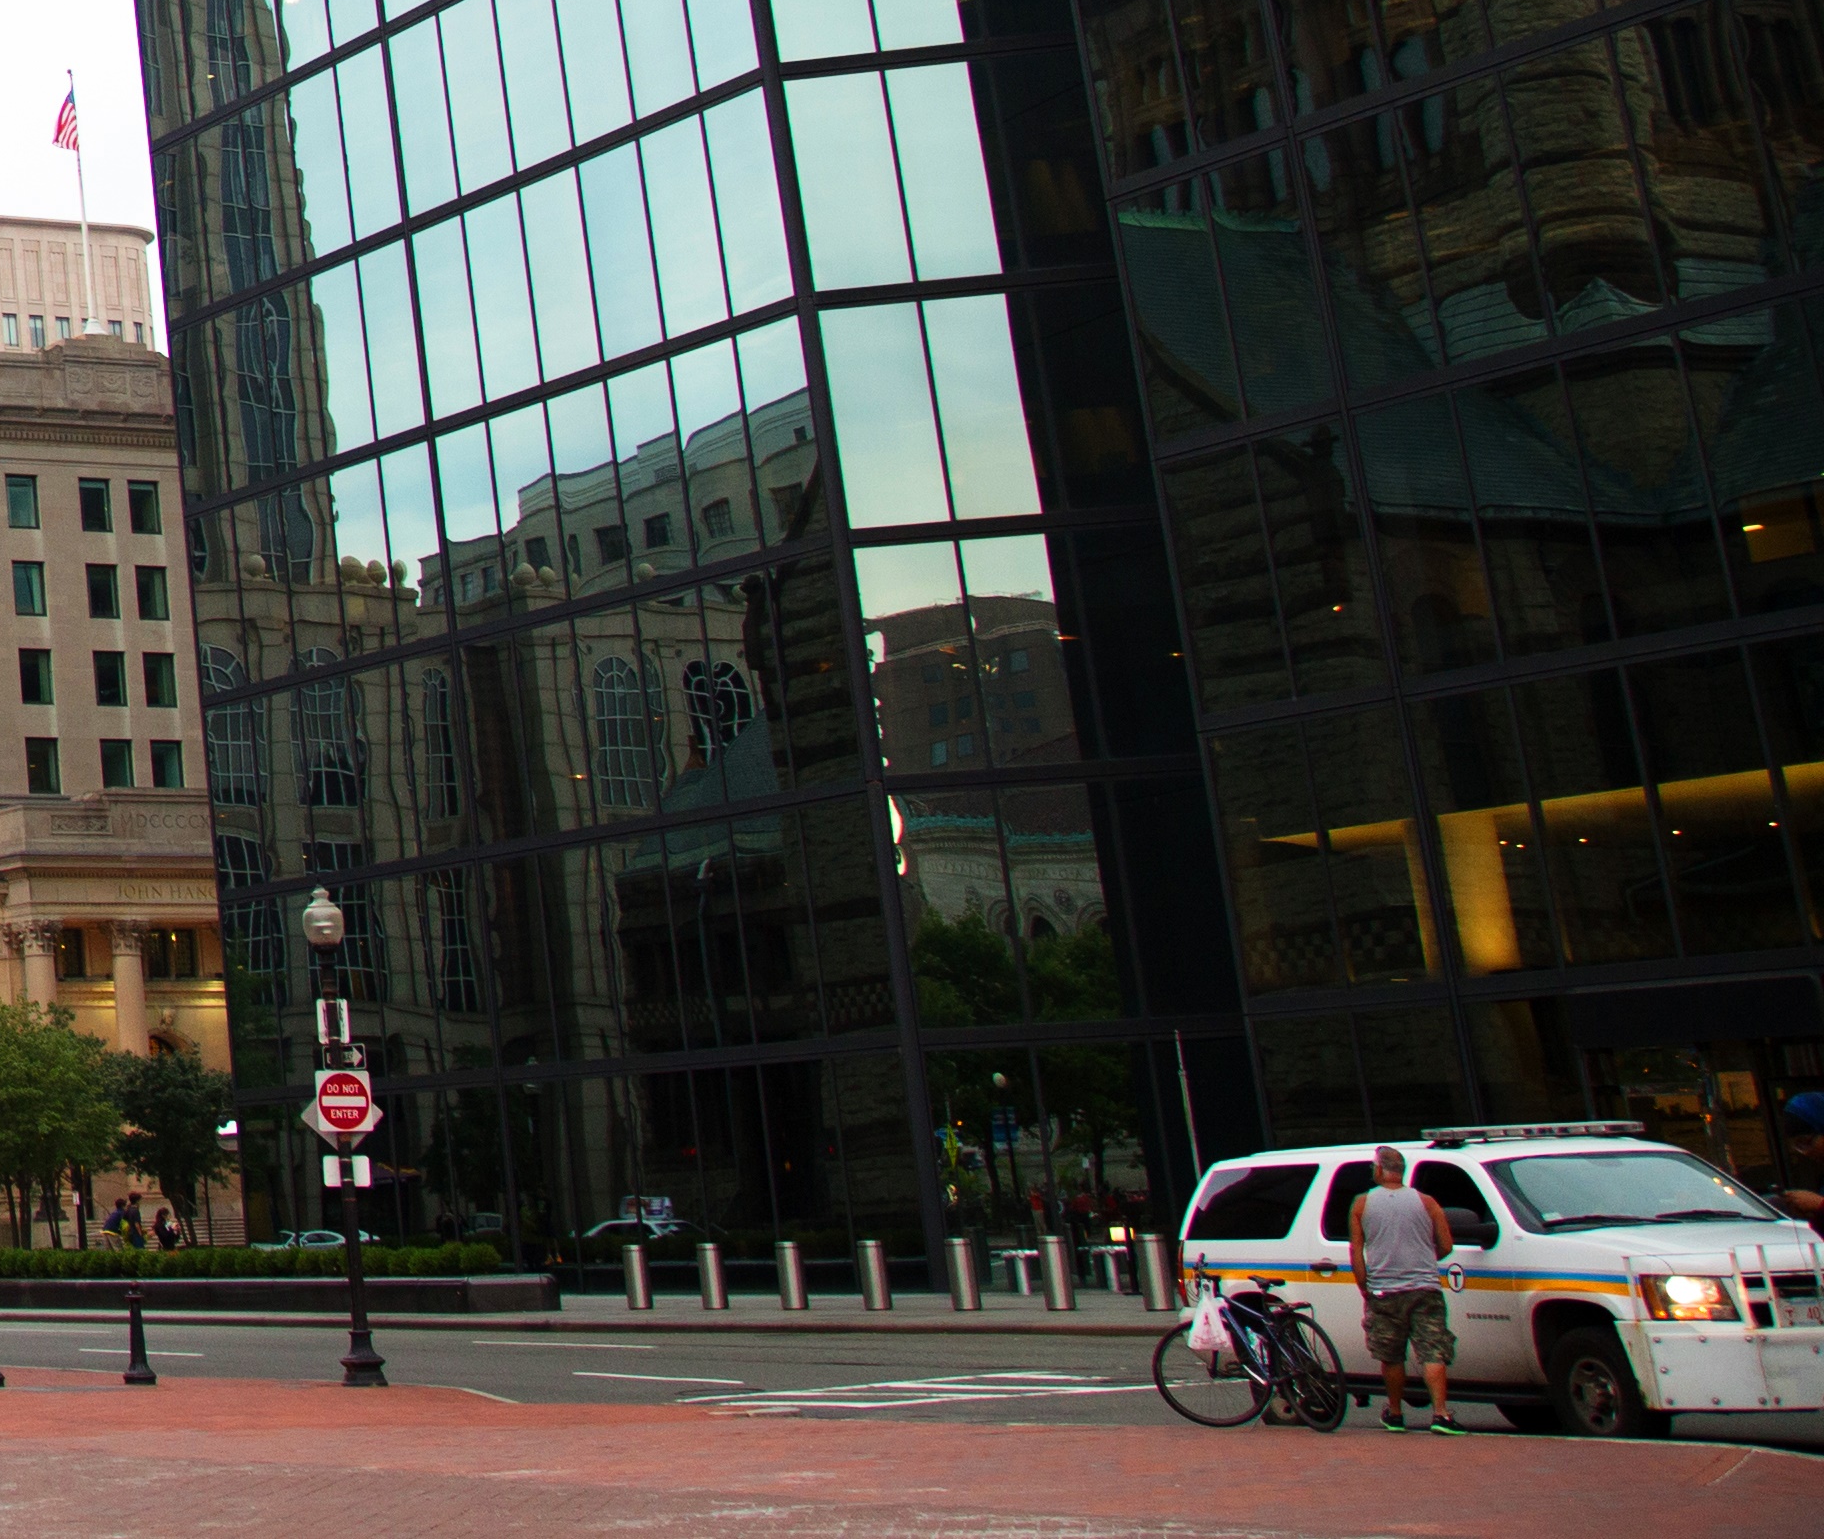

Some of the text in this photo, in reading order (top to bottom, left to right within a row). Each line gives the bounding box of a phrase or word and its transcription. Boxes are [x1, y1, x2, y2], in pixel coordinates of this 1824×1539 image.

[116, 885, 162, 900] JOHN
[326, 1084, 360, 1094] DO NOT
[330, 1109, 360, 1119] ENTER
[1450, 1271, 1461, 1288] T
